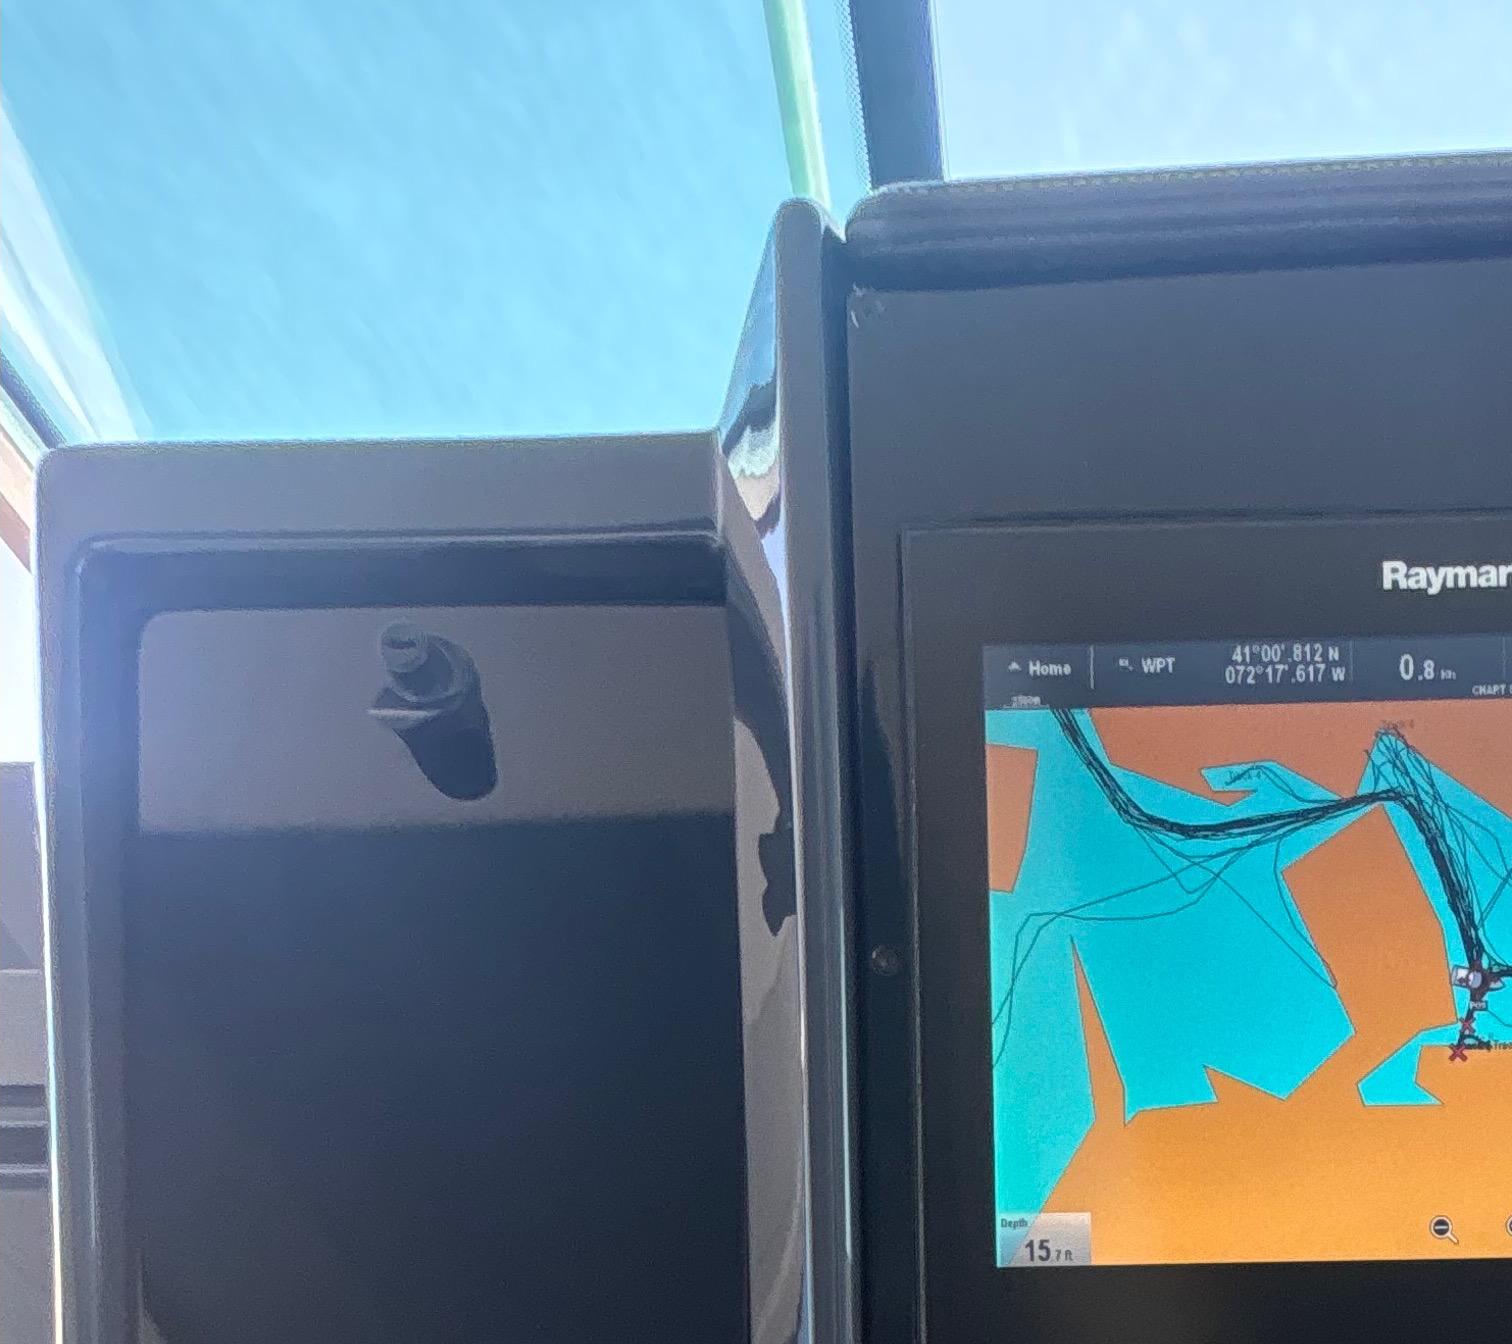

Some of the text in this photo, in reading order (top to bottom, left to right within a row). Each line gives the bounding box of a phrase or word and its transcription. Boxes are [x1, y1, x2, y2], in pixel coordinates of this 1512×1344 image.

[1029, 660, 1072, 677] Home
[1142, 657, 1176, 673] WPT
[1399, 654, 1435, 680] 0.8
[1000, 1218, 1028, 1230] Depth
